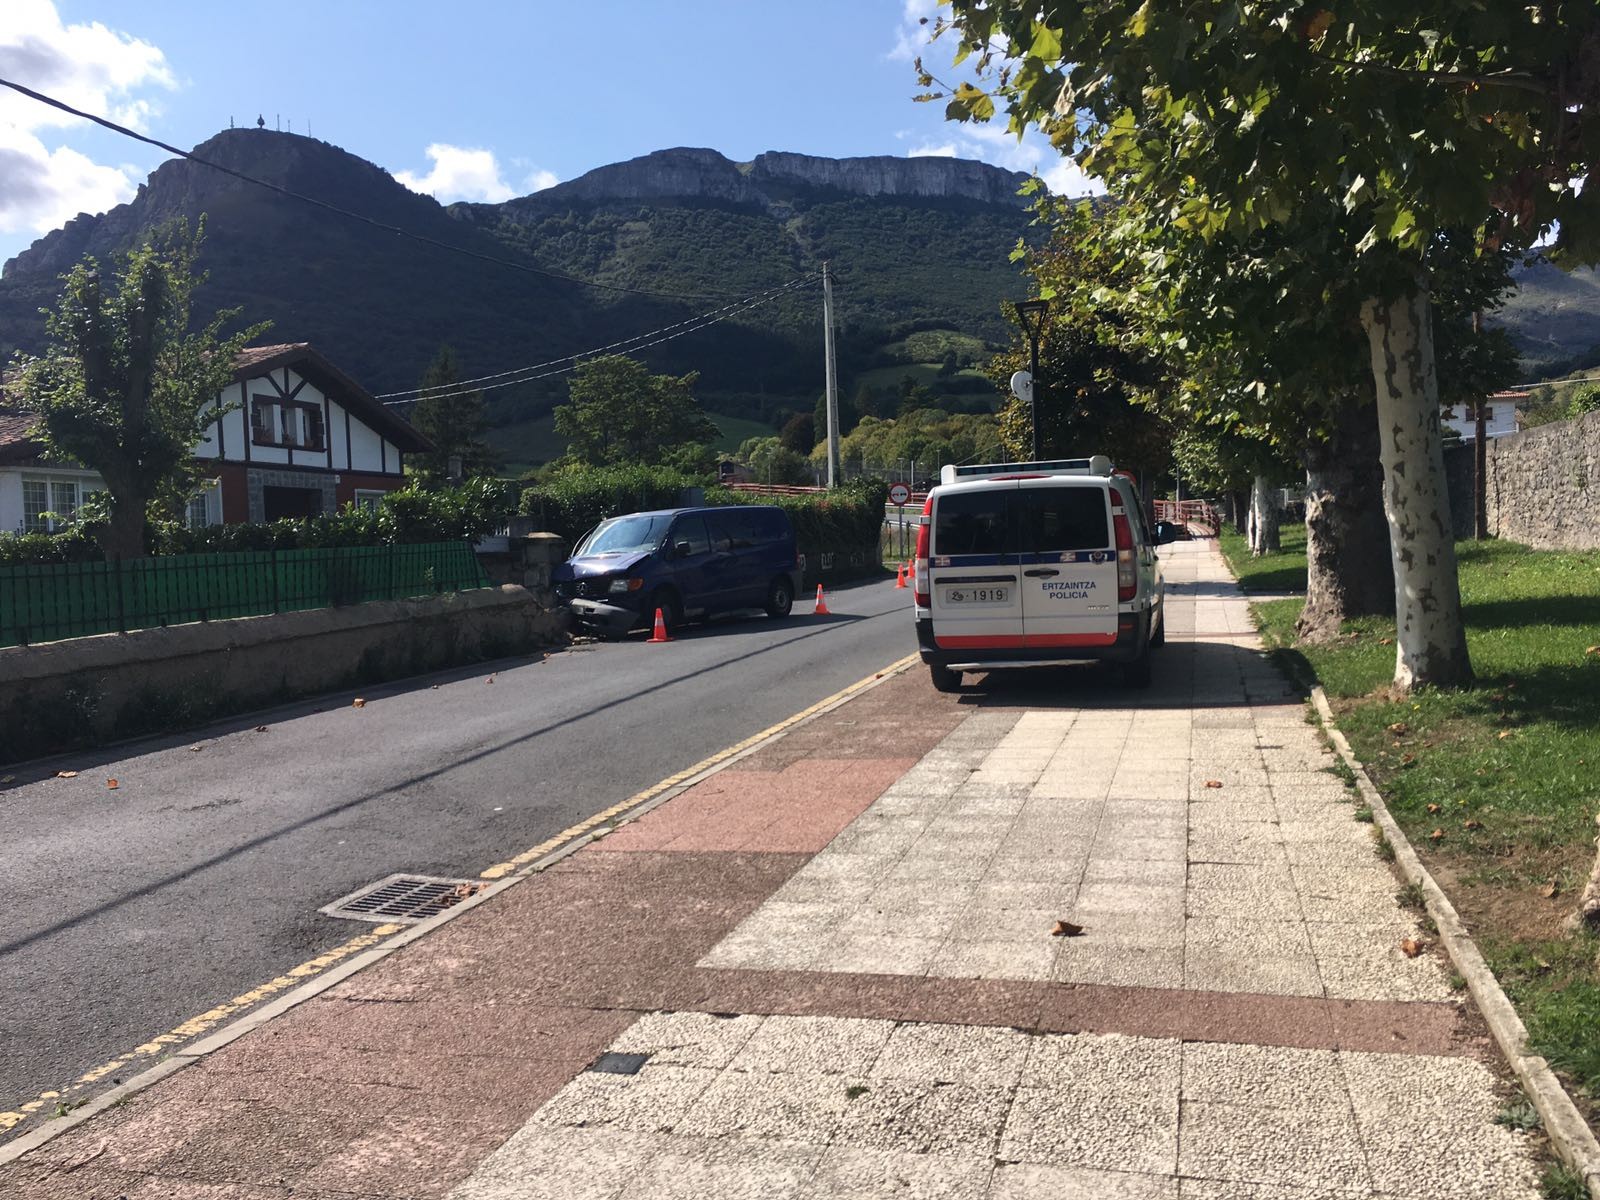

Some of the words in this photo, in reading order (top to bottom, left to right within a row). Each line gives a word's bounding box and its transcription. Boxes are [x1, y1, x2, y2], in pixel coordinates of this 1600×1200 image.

[1042, 581, 1096, 591] ERTZAINTZA
[973, 589, 1003, 601] 1919
[1049, 591, 1088, 600] POLICIA
